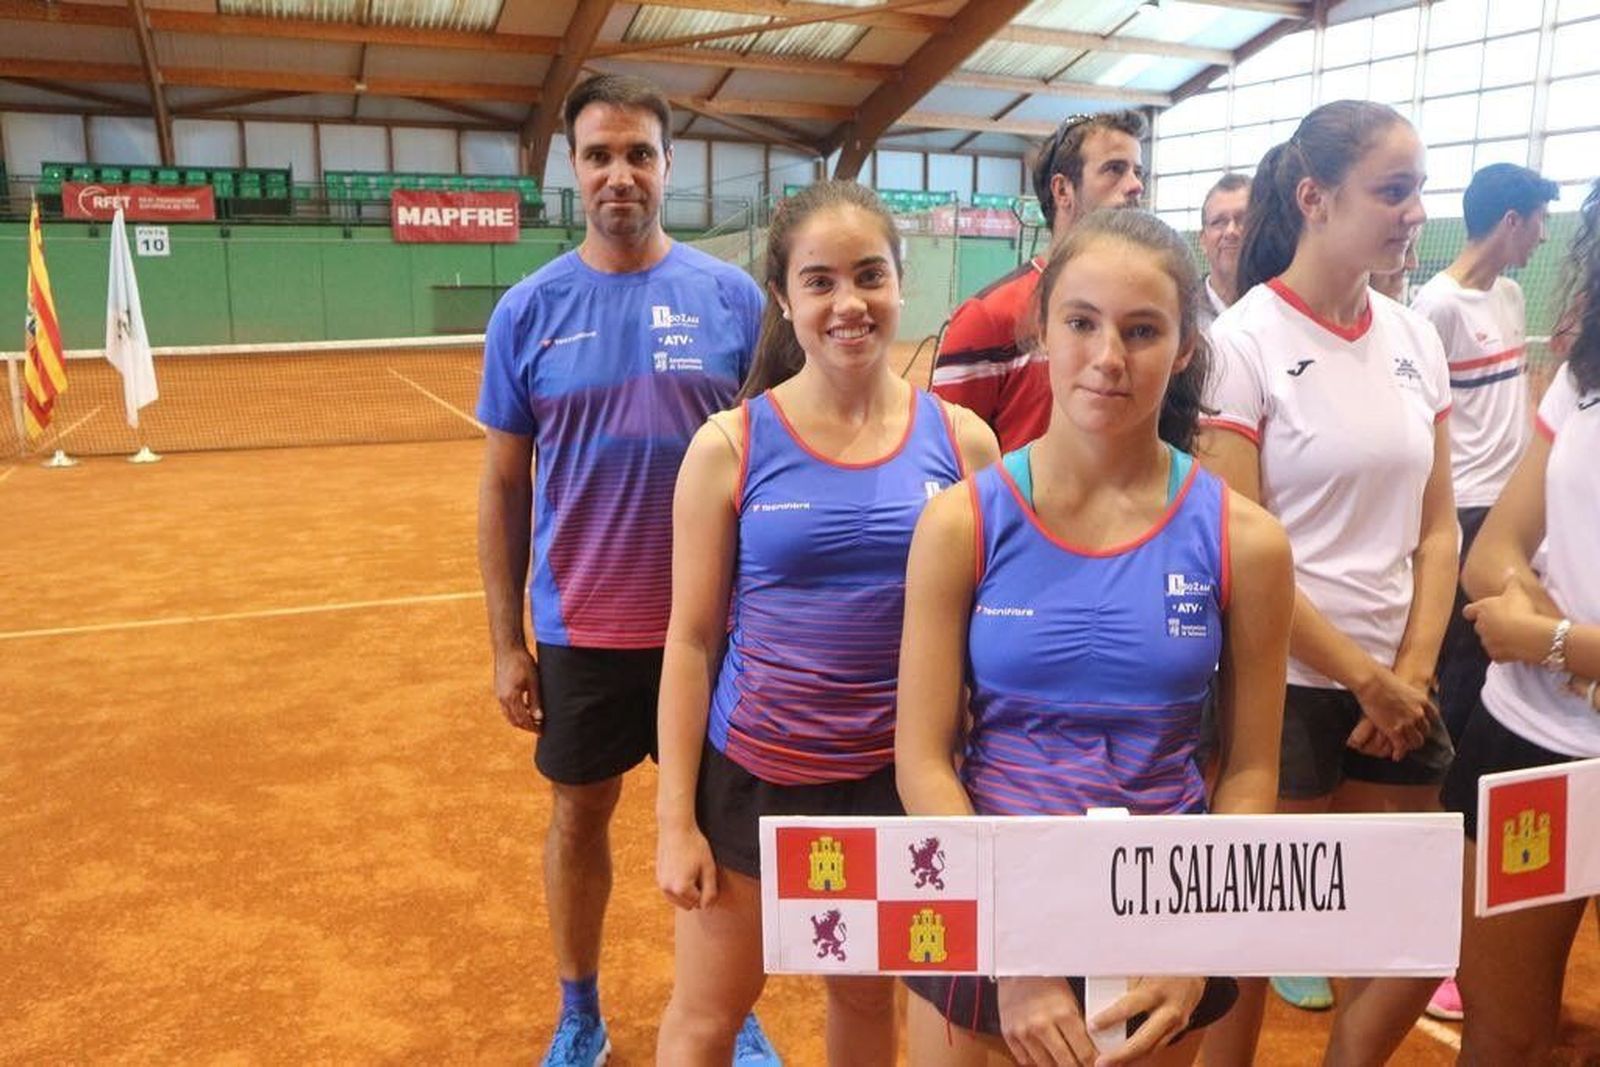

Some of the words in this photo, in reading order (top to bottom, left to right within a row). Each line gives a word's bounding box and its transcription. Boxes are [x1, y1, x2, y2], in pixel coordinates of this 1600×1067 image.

[93, 195, 131, 210] RFET
[397, 205, 514, 227] MAPFRE
[141, 238, 165, 252] 10
[663, 334, 689, 347] ATV
[1177, 602, 1199, 614] ATV
[1110, 845, 1161, 916] C.T.
[1168, 841, 1347, 915] SALAMANCA
